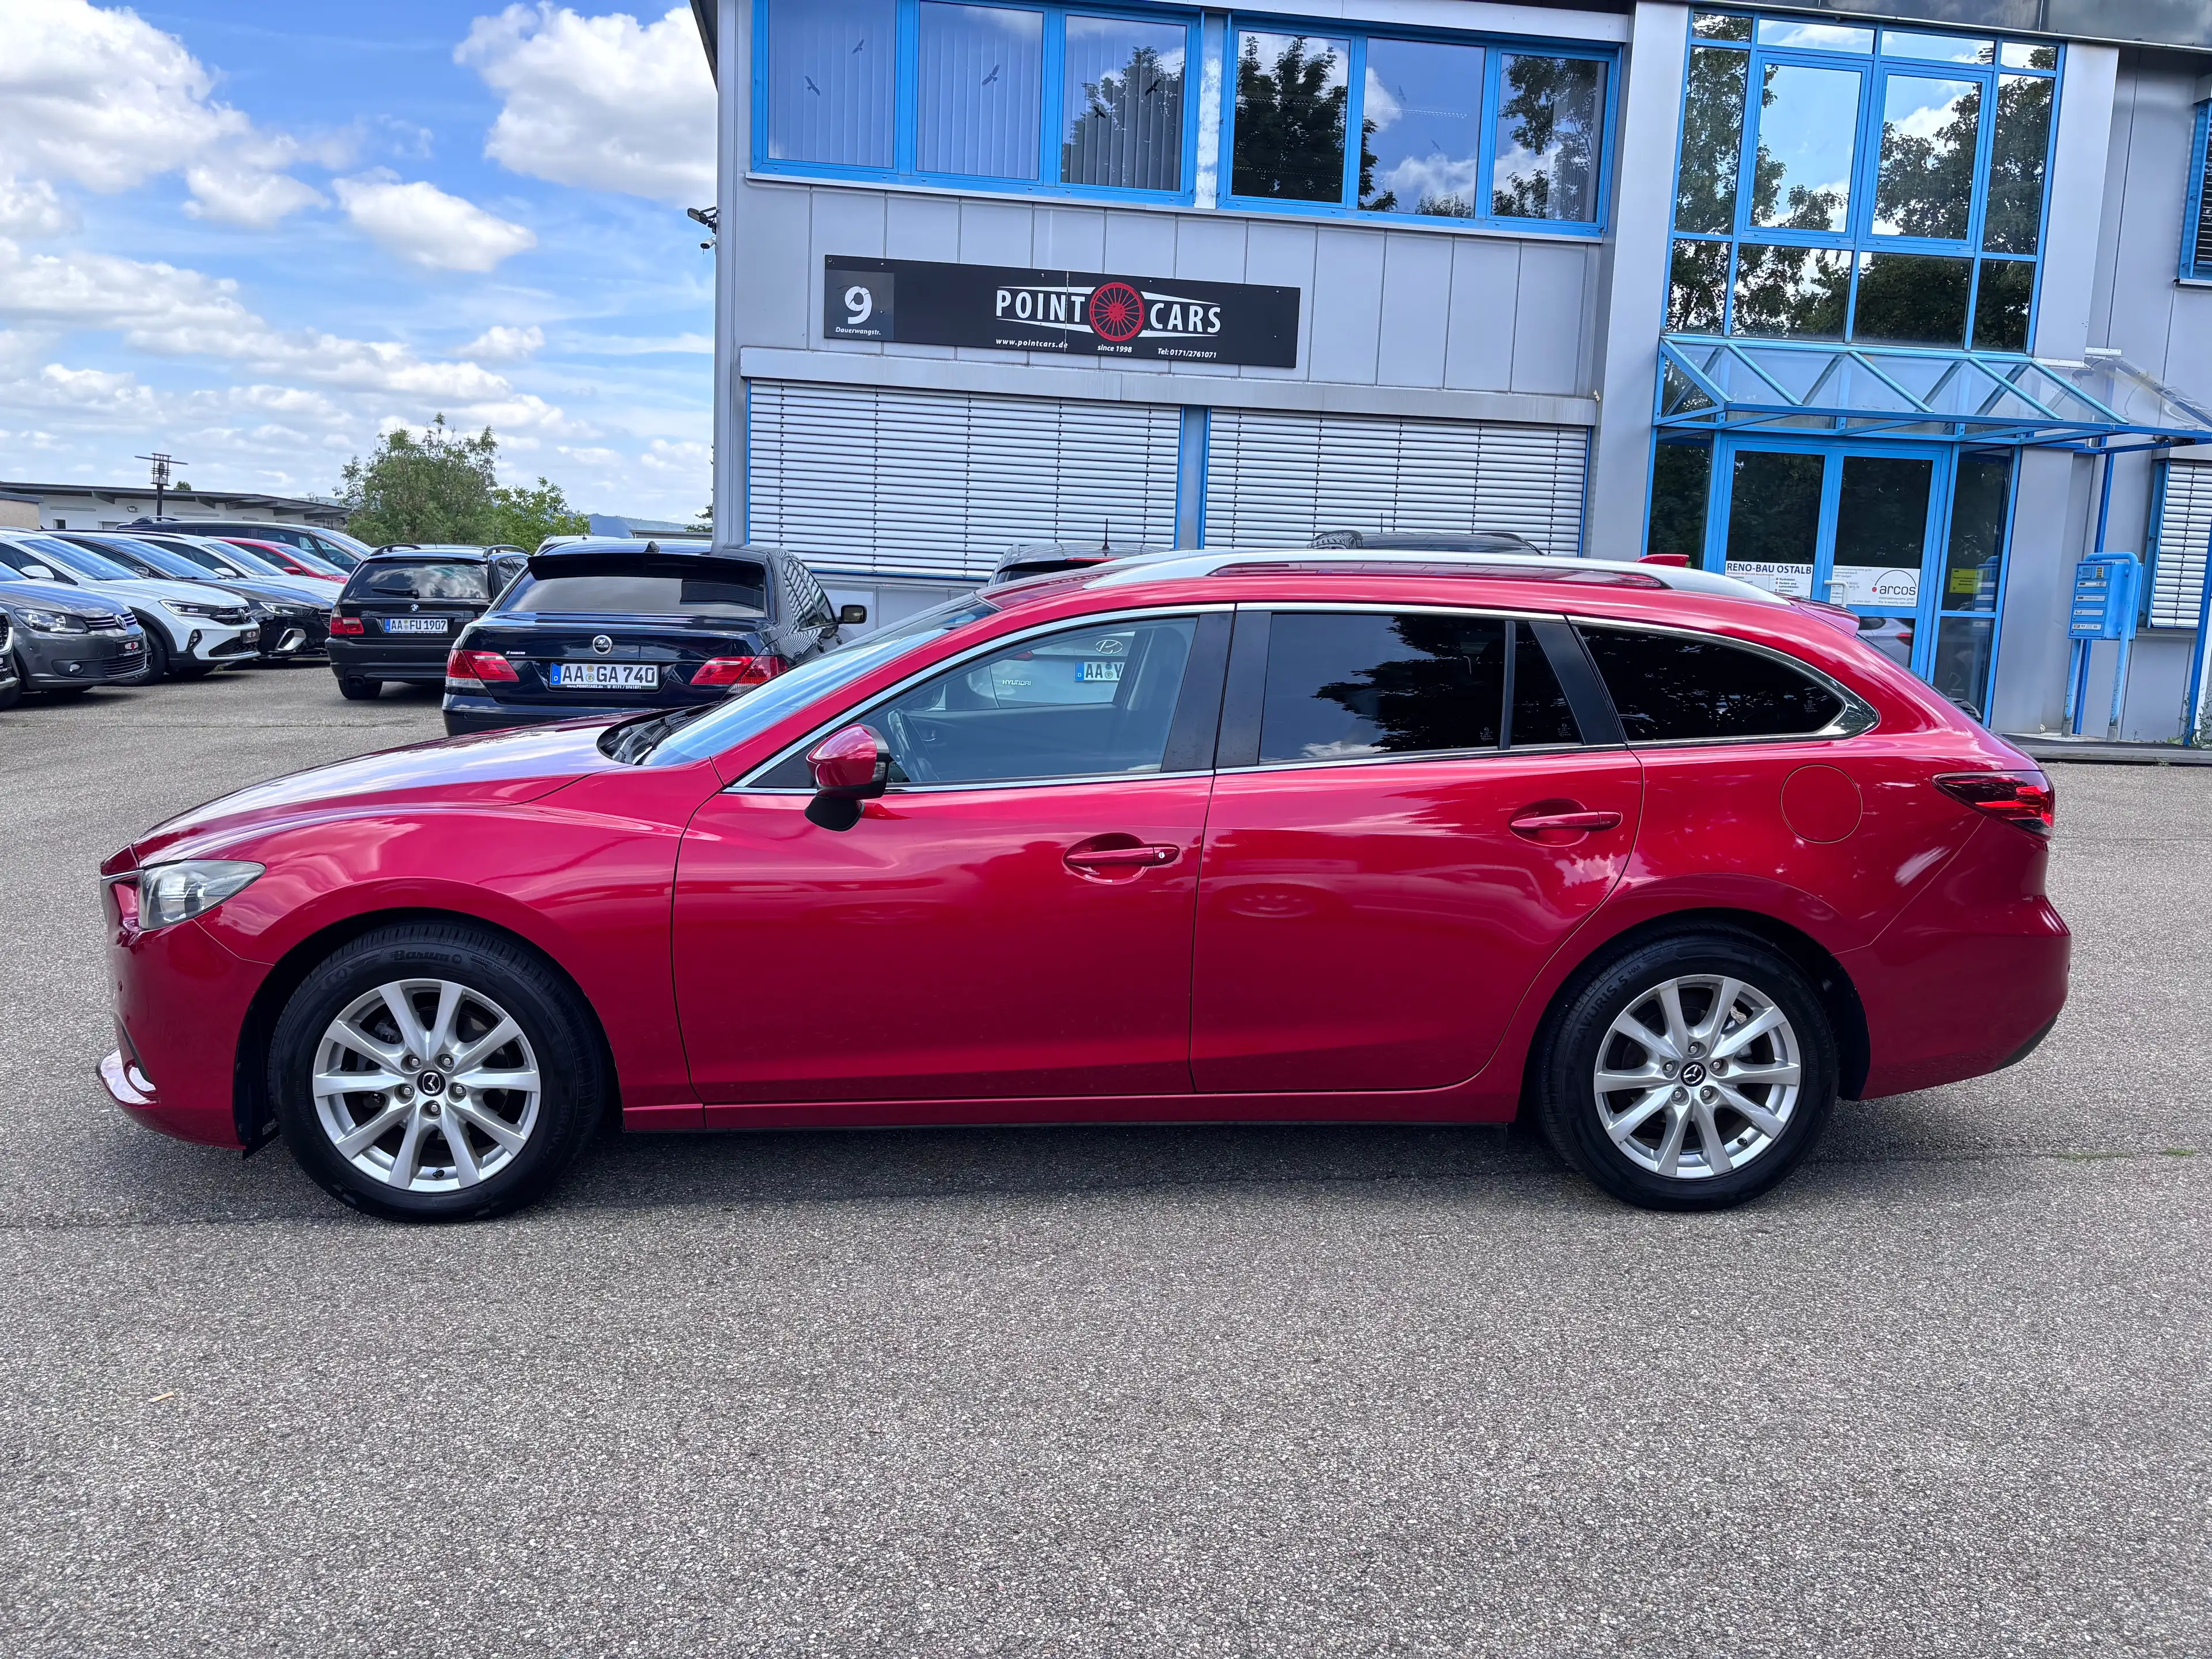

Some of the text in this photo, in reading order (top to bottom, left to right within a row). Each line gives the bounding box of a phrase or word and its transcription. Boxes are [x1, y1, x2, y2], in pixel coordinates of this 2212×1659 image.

[844, 286, 873, 324] 9
[996, 290, 1221, 334] POINT CARS
[835, 327, 881, 336] Dauerwangstr.
[995, 338, 1068, 349] www.pointcars.de
[1169, 349, 1217, 358] 0171/2761071
[1726, 563, 1775, 573] RENO-BAU
[1777, 565, 1812, 574] OSTALB
[1879, 585, 1916, 596] arcos
[392, 620, 403, 630] AA
[410, 620, 422, 630] FU
[423, 620, 446, 630] 1907
[562, 665, 584, 682] AA
[596, 666, 619, 683] GA
[623, 666, 655, 683] 740
[1085, 664, 1103, 678] AA
[389, 950, 450, 961] Barum
[1570, 984, 1618, 1058] RAVURIS
